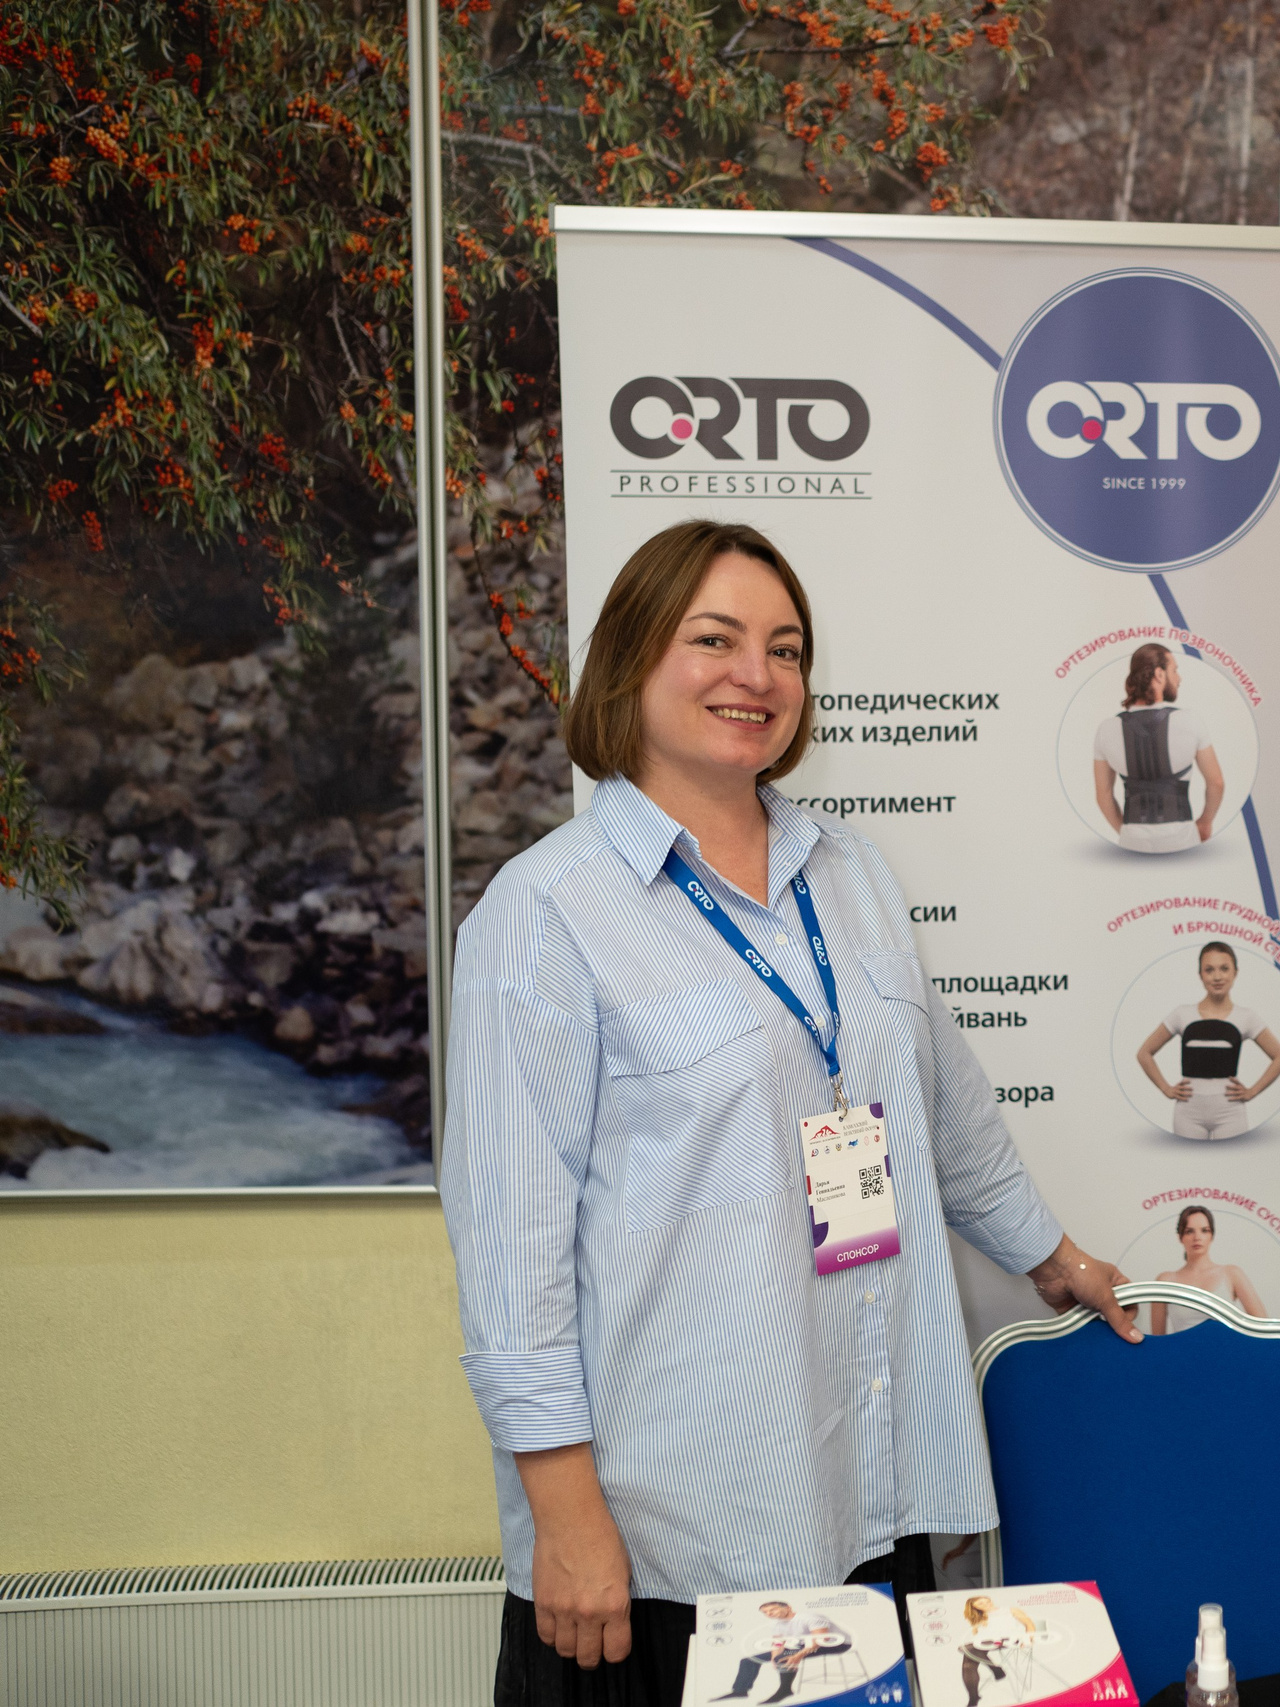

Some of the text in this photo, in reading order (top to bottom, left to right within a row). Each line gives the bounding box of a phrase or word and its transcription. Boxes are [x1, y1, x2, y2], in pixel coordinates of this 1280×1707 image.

[609, 375, 871, 462] ORTO
[1026, 380, 1262, 461] ORTO
[619, 475, 866, 495] PROFESSIONAL
[1102, 477, 1187, 490] SINCE 1999
[1055, 626, 1262, 707] ОРТЕЗИРОВАНИЕ ПОЗВОНОЧНИКА
[861, 718, 979, 747] изделий
[687, 881, 714, 911] ORTO
[1107, 896, 1220, 933] ОРТЕЗИРОВАНИЕ
[1173, 923, 1184, 936] И
[1187, 921, 1264, 947] БРЮШНОЙ
[745, 949, 772, 978] ORTO
[812, 936, 828, 967] ORTO
[932, 974, 1069, 995] площадки
[1142, 1187, 1258, 1212] ОРТЕЗИРОВАНИЕ
[837, 1243, 880, 1263] СПОНСОР
